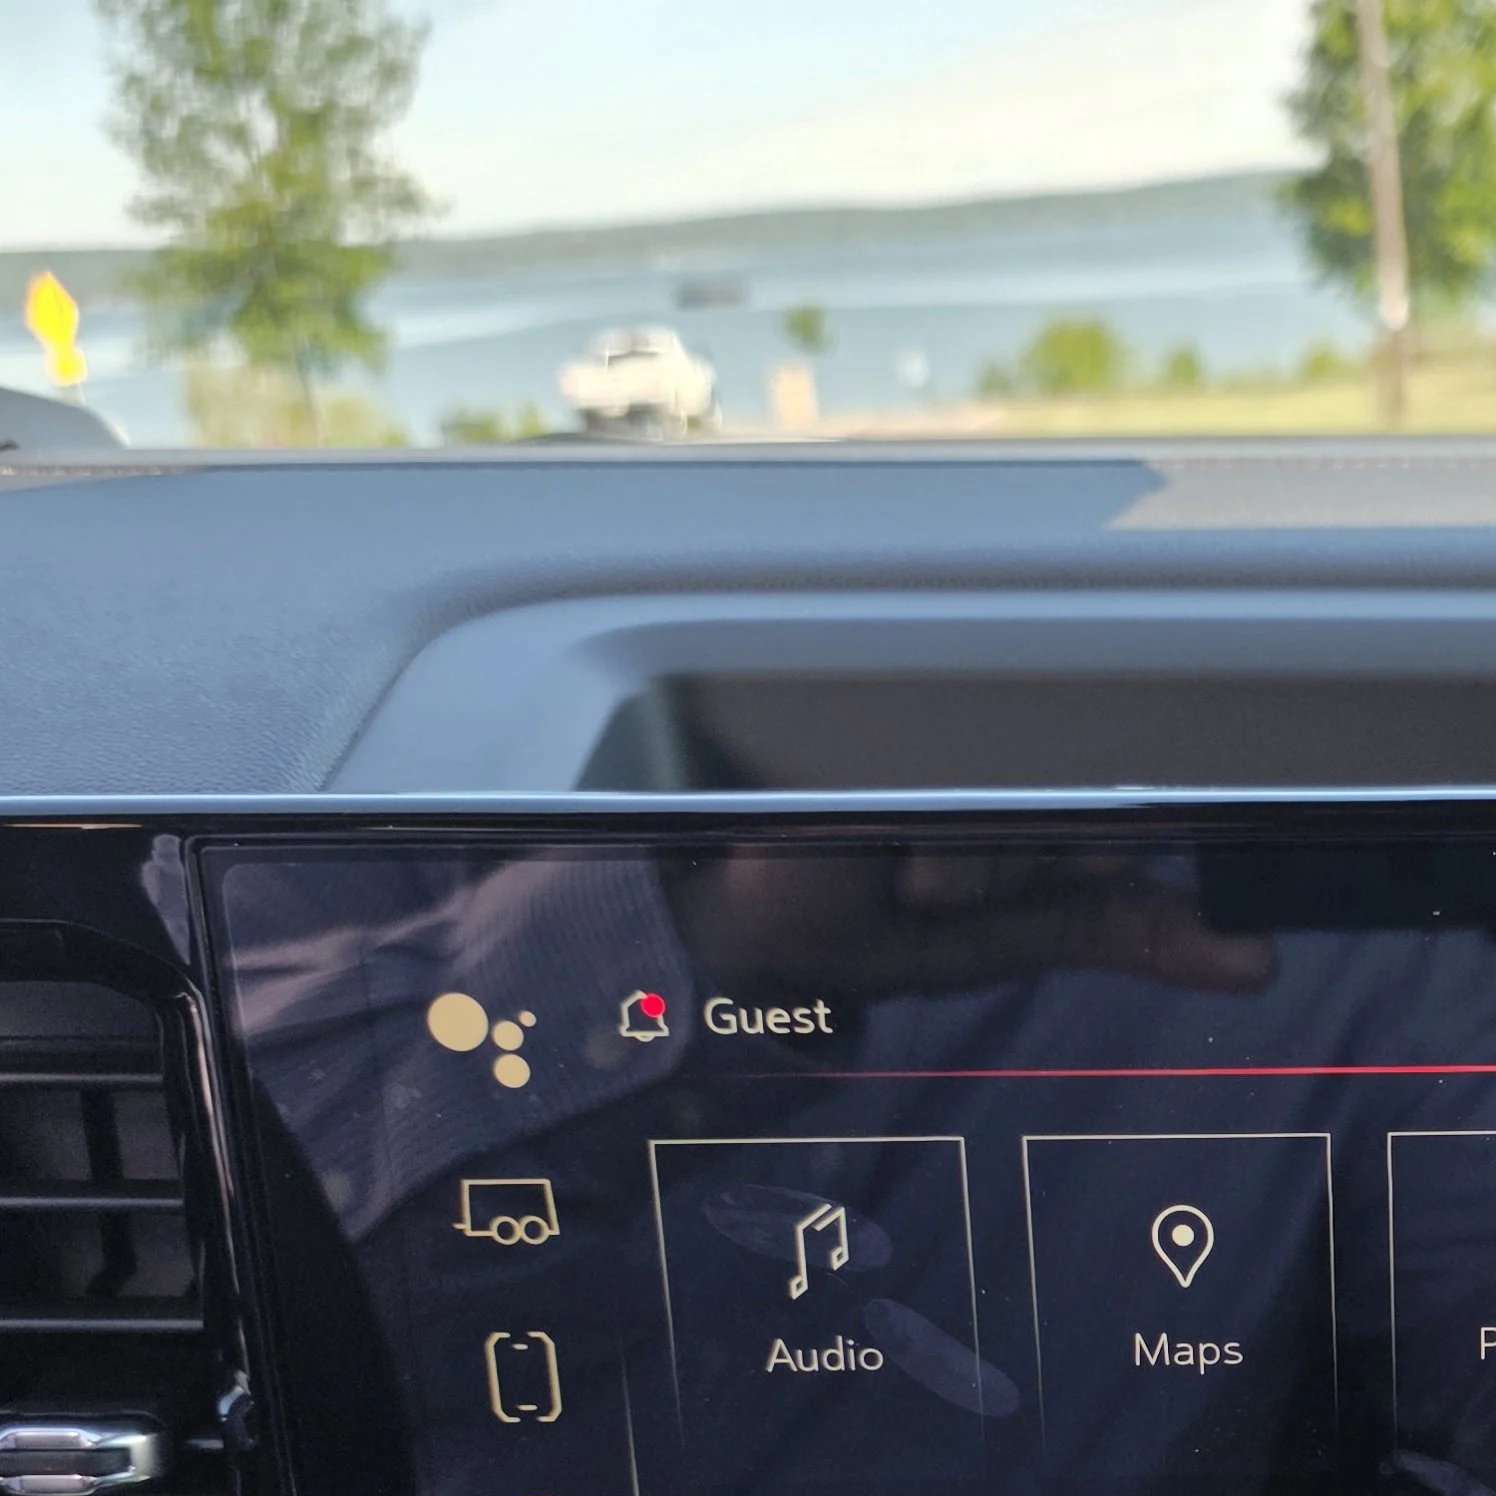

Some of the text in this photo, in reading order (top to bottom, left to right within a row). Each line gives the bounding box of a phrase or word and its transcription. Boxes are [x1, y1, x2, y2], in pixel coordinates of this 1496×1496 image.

[704, 997, 834, 1035] Guest
[765, 1335, 884, 1373] Audio
[1134, 1332, 1244, 1375] Maps
